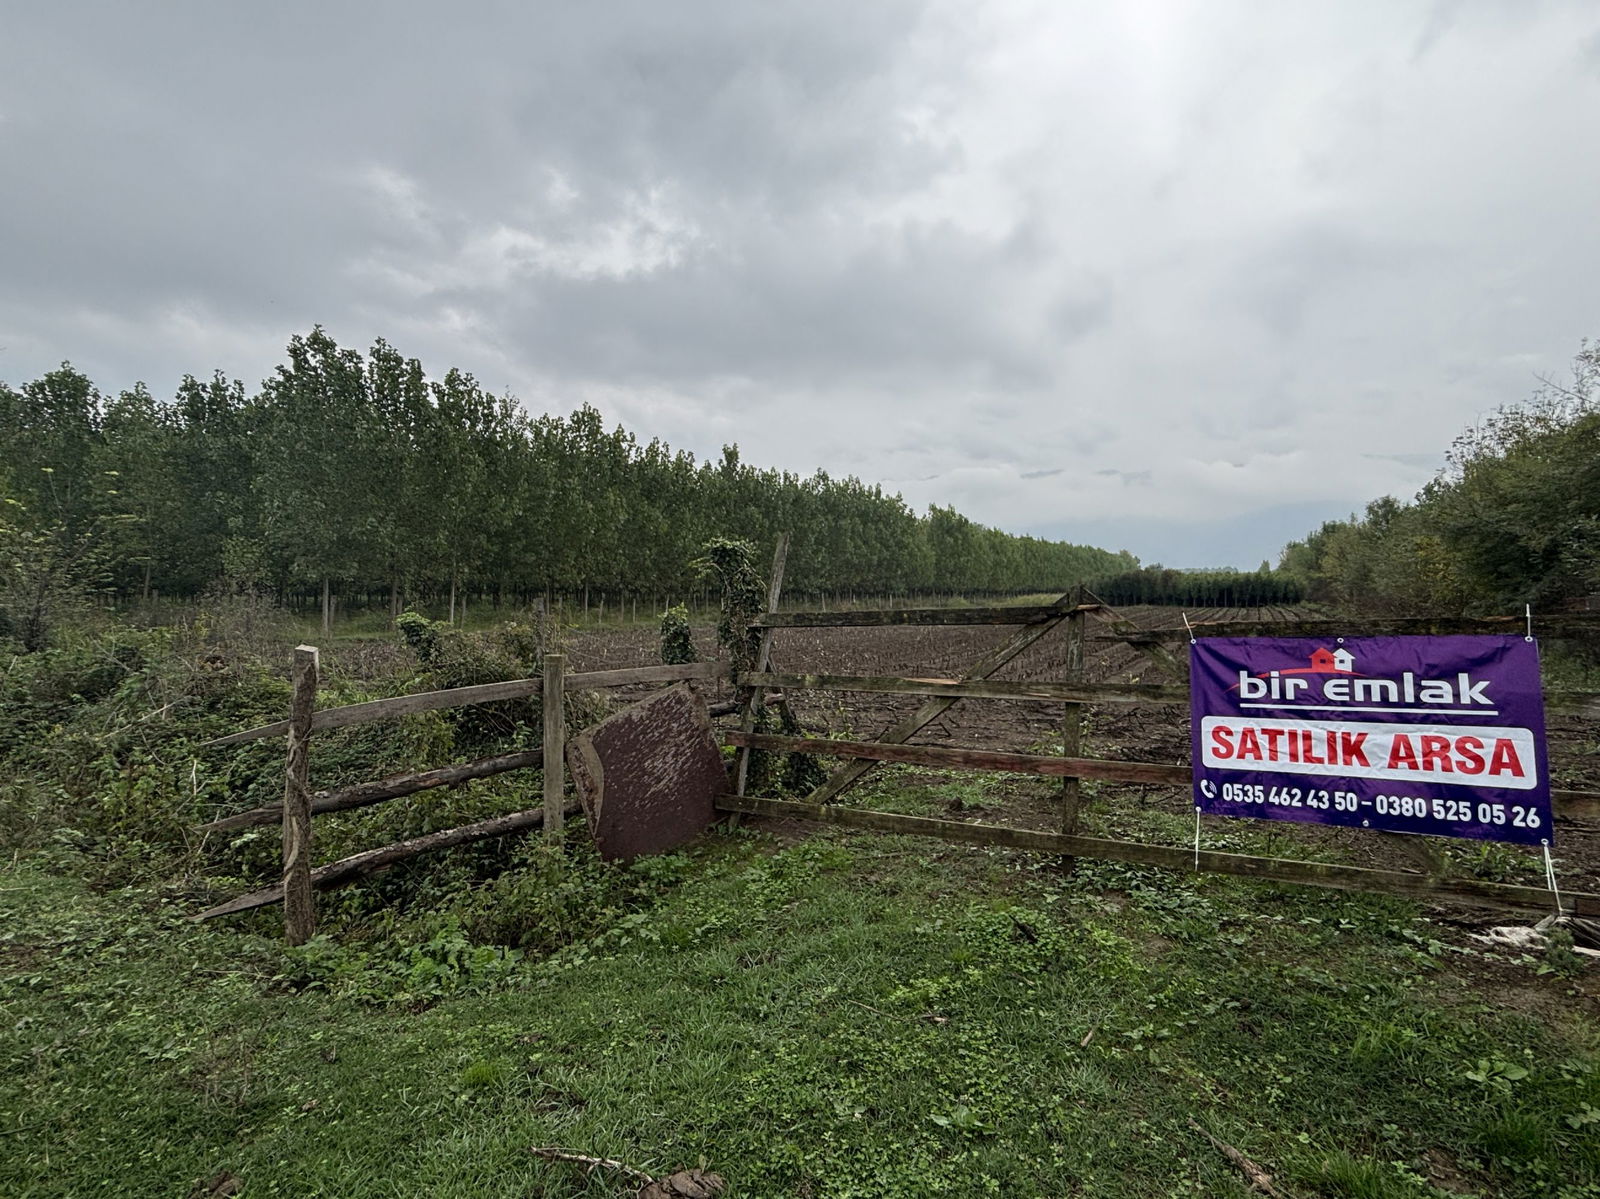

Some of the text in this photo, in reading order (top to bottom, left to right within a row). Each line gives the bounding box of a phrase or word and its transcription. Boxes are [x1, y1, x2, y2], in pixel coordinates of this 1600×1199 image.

[1239, 670, 1494, 705] bir emlak
[1211, 725, 1526, 778] SATILIK ARSA
[1222, 783, 1265, 804] 0535
[1269, 786, 1302, 807] 462
[1307, 789, 1330, 810] 43
[1335, 791, 1358, 812] 50
[1376, 794, 1427, 818] 0380
[1433, 799, 1472, 822] 525
[1477, 802, 1506, 825] 05
[1512, 806, 1541, 828] 26
